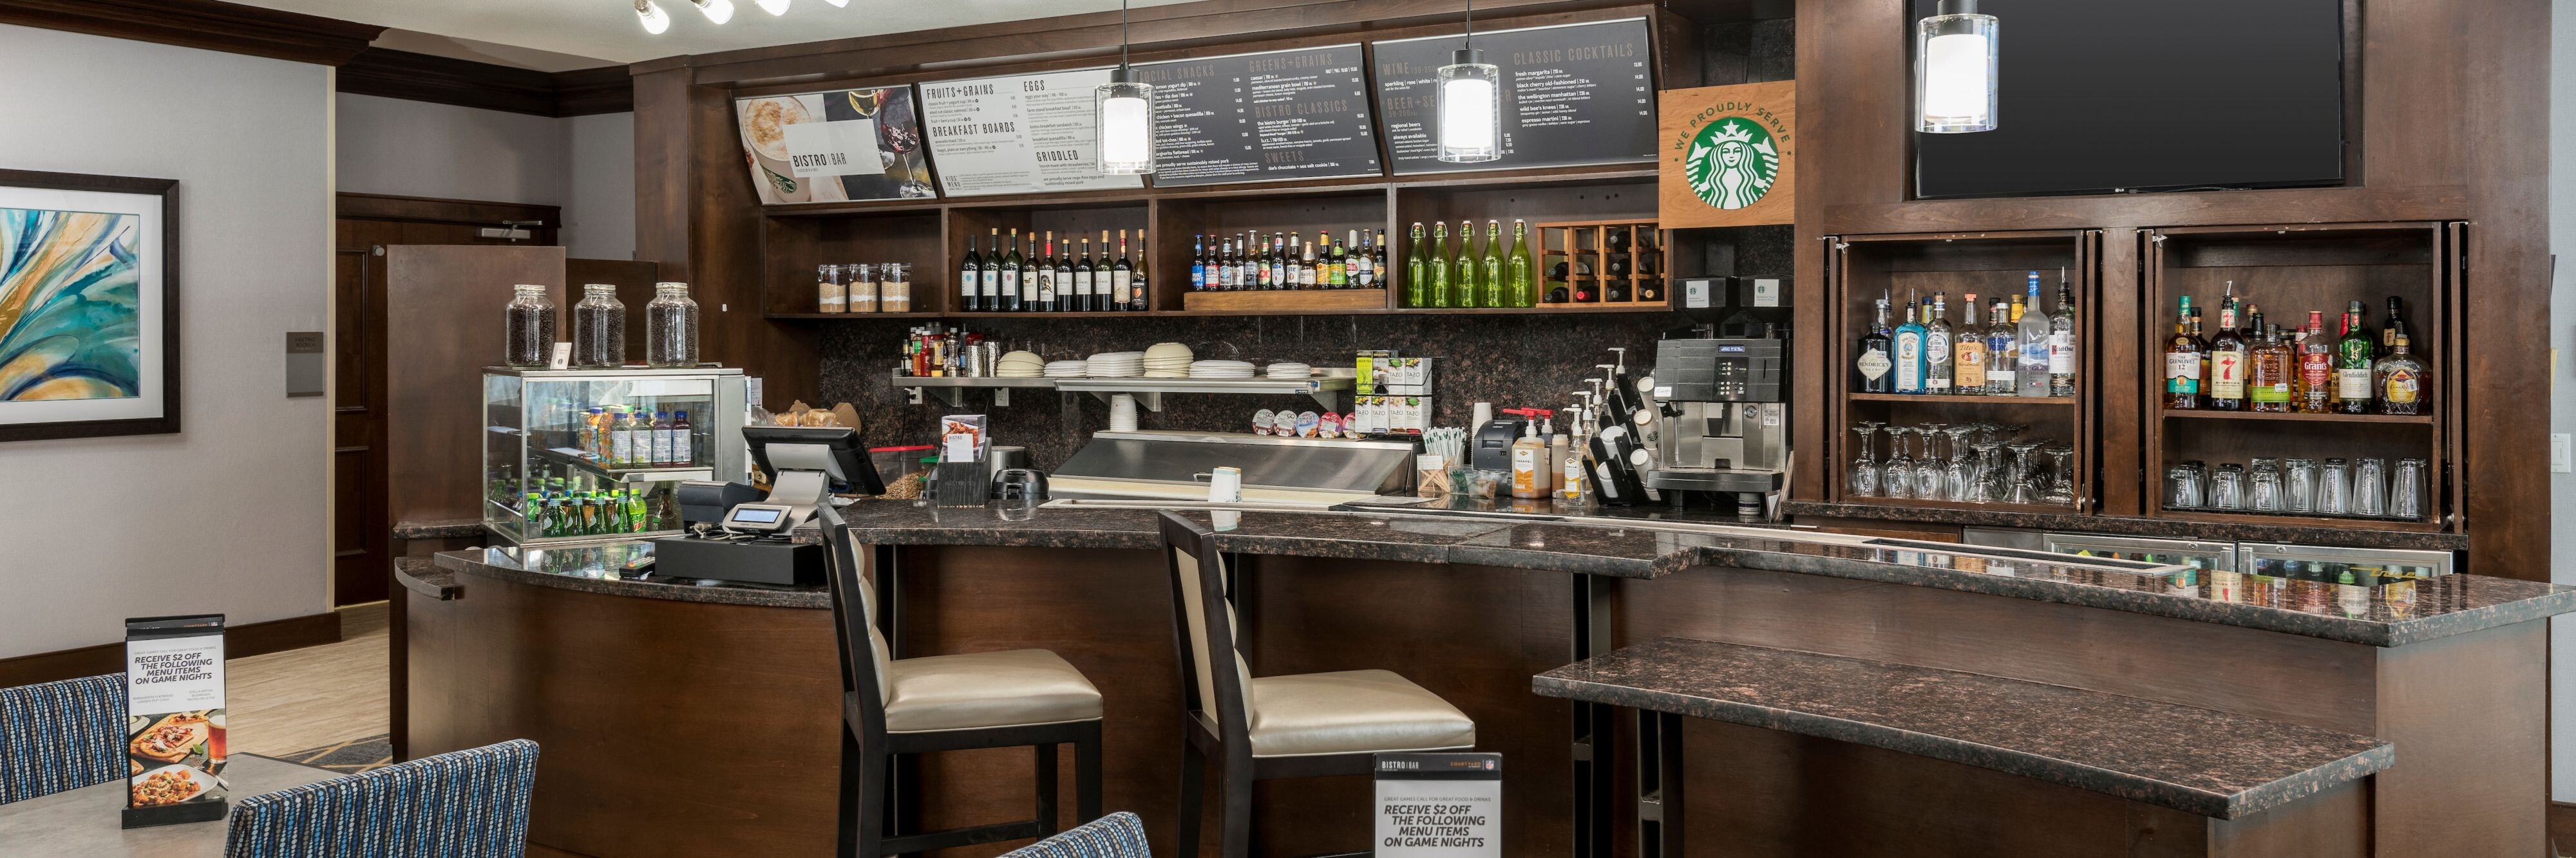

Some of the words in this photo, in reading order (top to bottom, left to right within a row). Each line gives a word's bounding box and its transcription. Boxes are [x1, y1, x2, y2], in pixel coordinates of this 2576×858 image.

[1514, 49, 1561, 65] CLASSIC
[1568, 43, 1633, 61] COCKTAILS
[1249, 53, 1333, 73] GREENS+GRAINS
[1383, 62, 1410, 76] WINE
[1139, 69, 1172, 83] SOCIAL
[1178, 65, 1215, 79] SNACKS
[927, 84, 993, 99] FRUITS+GRAINS
[1024, 80, 1045, 92] EGGS
[1255, 104, 1291, 118] BISTRO
[1297, 100, 1347, 114] CLASSICS
[933, 124, 977, 137] BREAKFAST
[983, 122, 1015, 134] BOARDS
[1675, 131, 1690, 150] WE
[1690, 102, 1752, 128] PROUDLY
[1757, 108, 1790, 143] SERVE
[793, 154, 827, 167] BISTRO
[831, 153, 846, 165] BAR
[1036, 150, 1078, 162] GRIDDLED
[1265, 151, 1304, 163] SWEETS
[2220, 359, 2236, 380] 7
[2304, 362, 2326, 370] Grant's
[135, 655, 171, 663] RECEIVE
[160, 659, 212, 668] FOLLOWING
[179, 673, 212, 681] NIGHTS
[1384, 805, 1431, 814] RECEIVE
[1433, 804, 1447, 815] $2
[1449, 805, 1471, 814] OFF
[1392, 816, 1414, 825] THE
[1417, 816, 1485, 825] FOLLOWING
[1399, 827, 1433, 836] MENU
[1436, 827, 1469, 836] ITEMS
[1384, 837, 1402, 846] ON
[1405, 837, 1438, 847] GAME
[1441, 838, 1484, 847] NIGHTS
